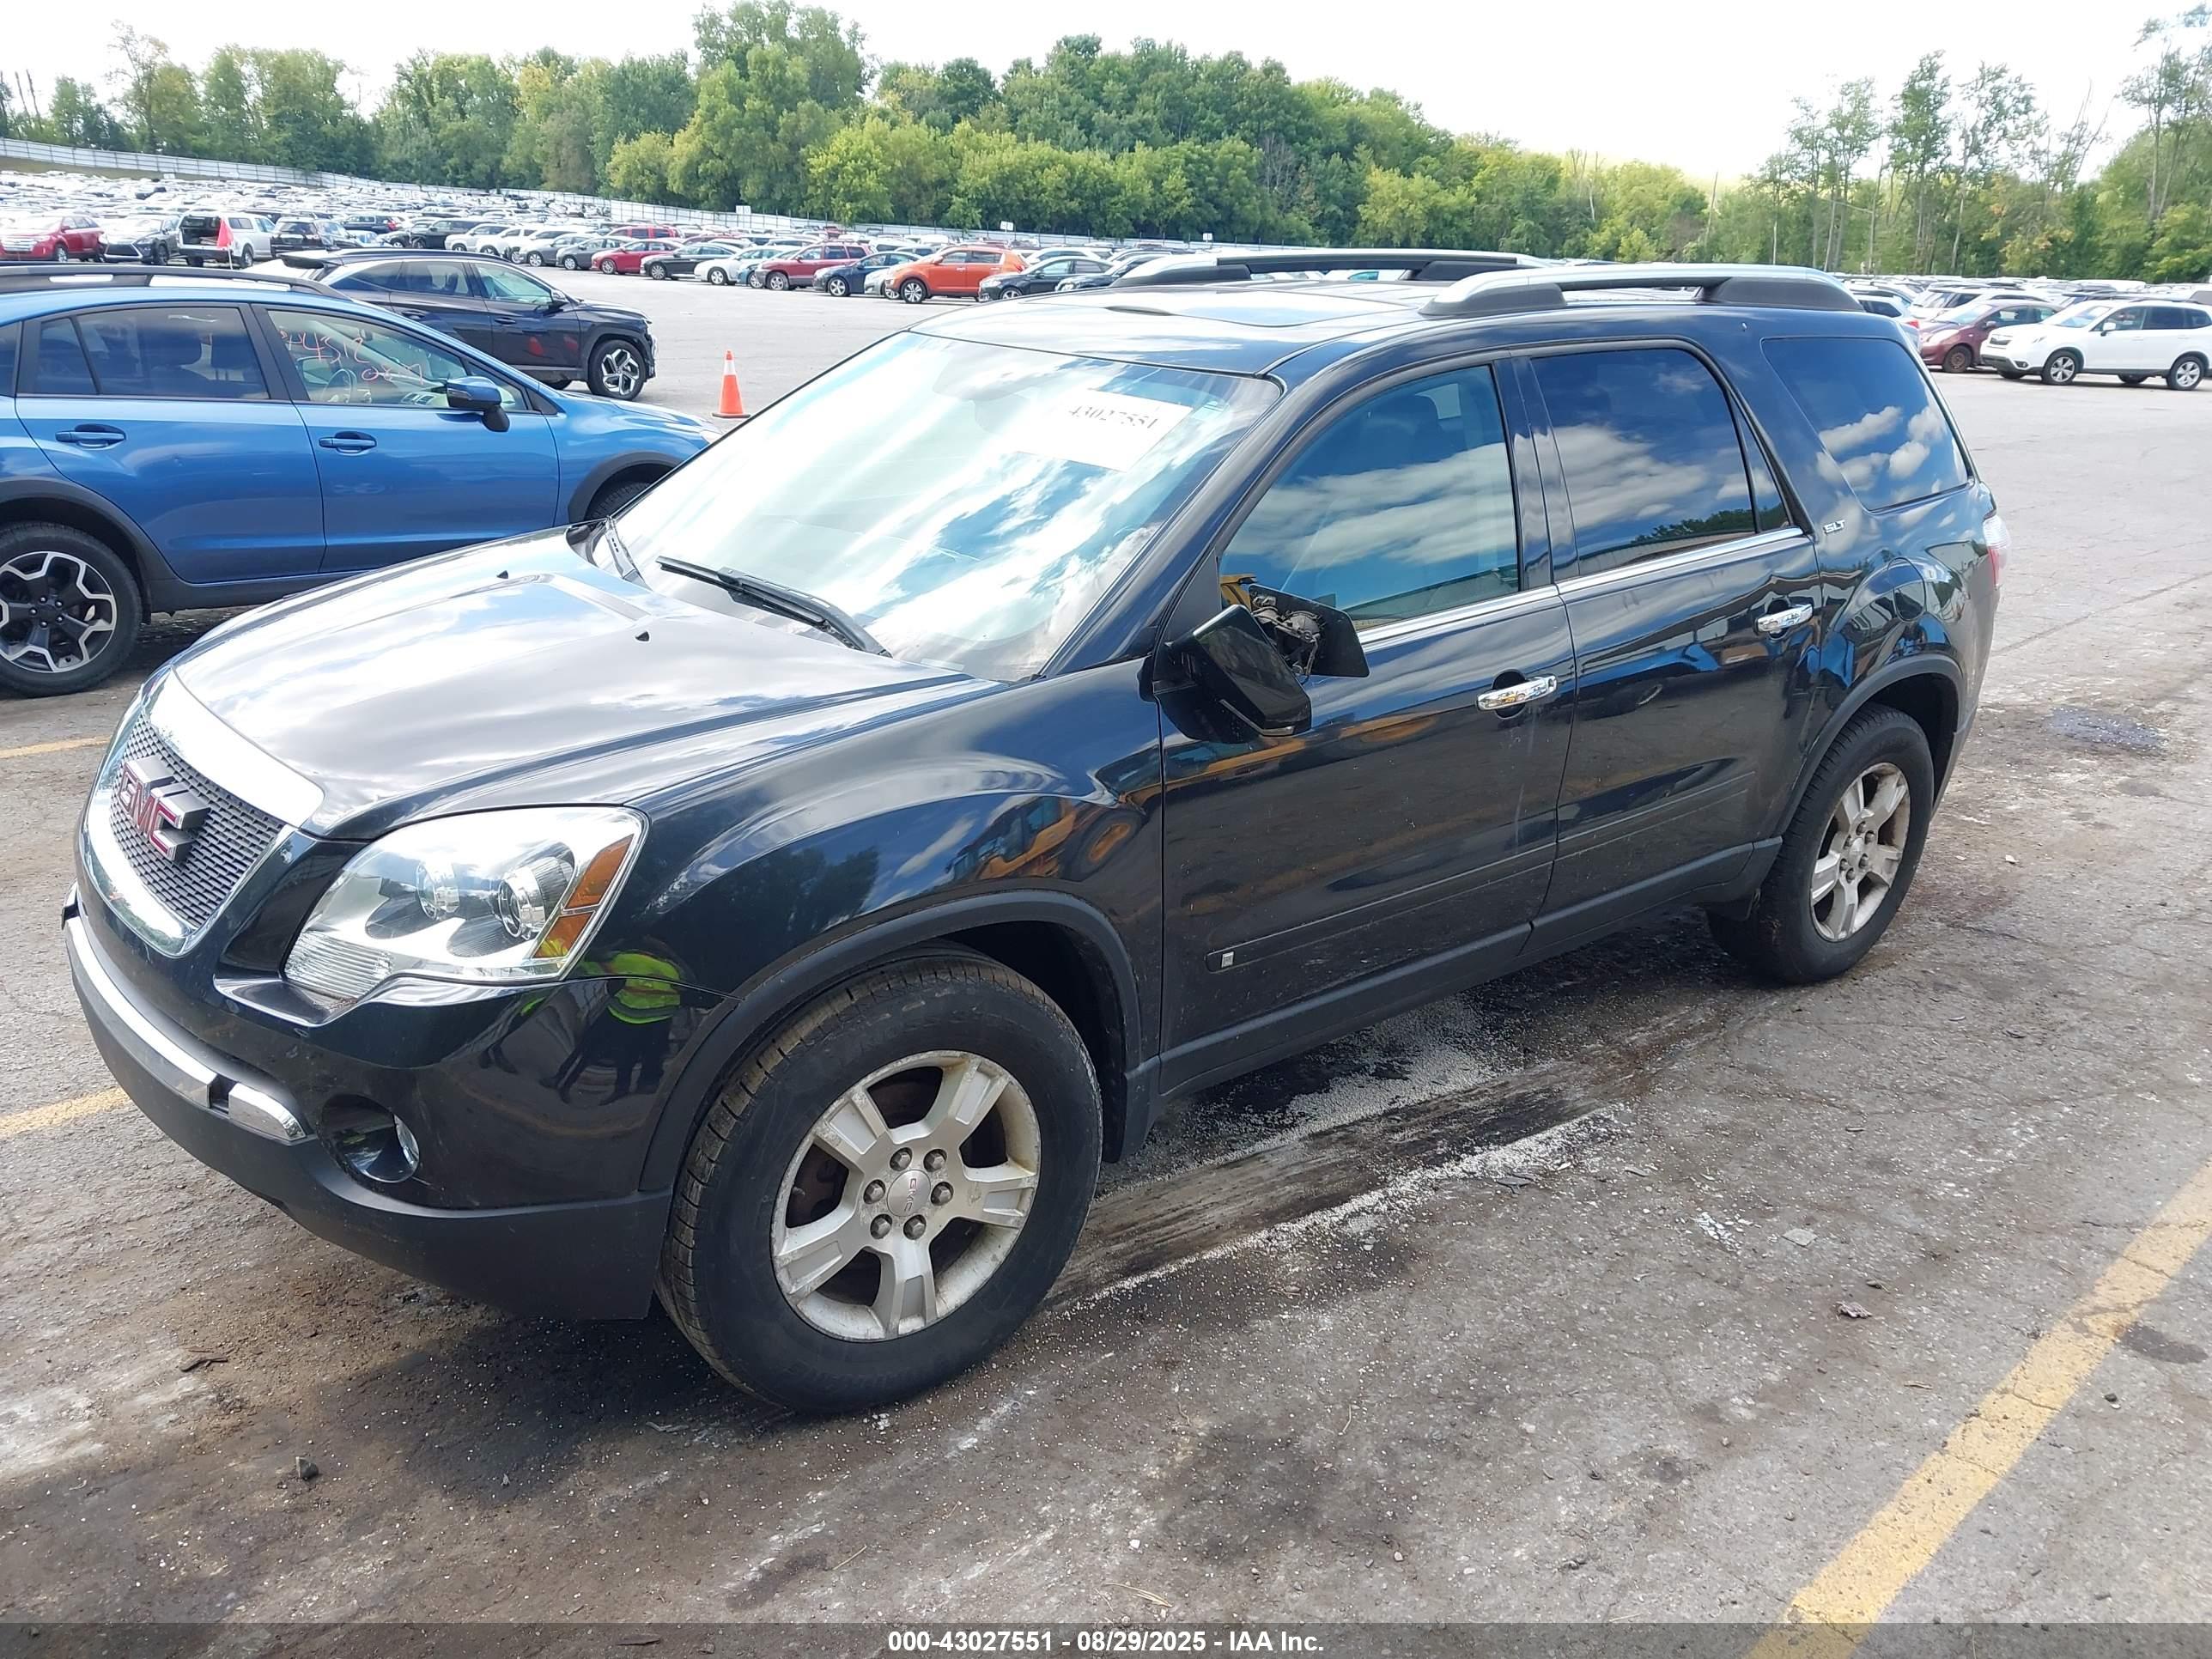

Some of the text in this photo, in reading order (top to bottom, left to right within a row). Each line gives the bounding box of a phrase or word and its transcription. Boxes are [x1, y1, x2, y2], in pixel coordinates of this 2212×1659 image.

[1823, 519, 1846, 534] SLT
[118, 757, 194, 861] GMC
[903, 1177, 918, 1212] GMC
